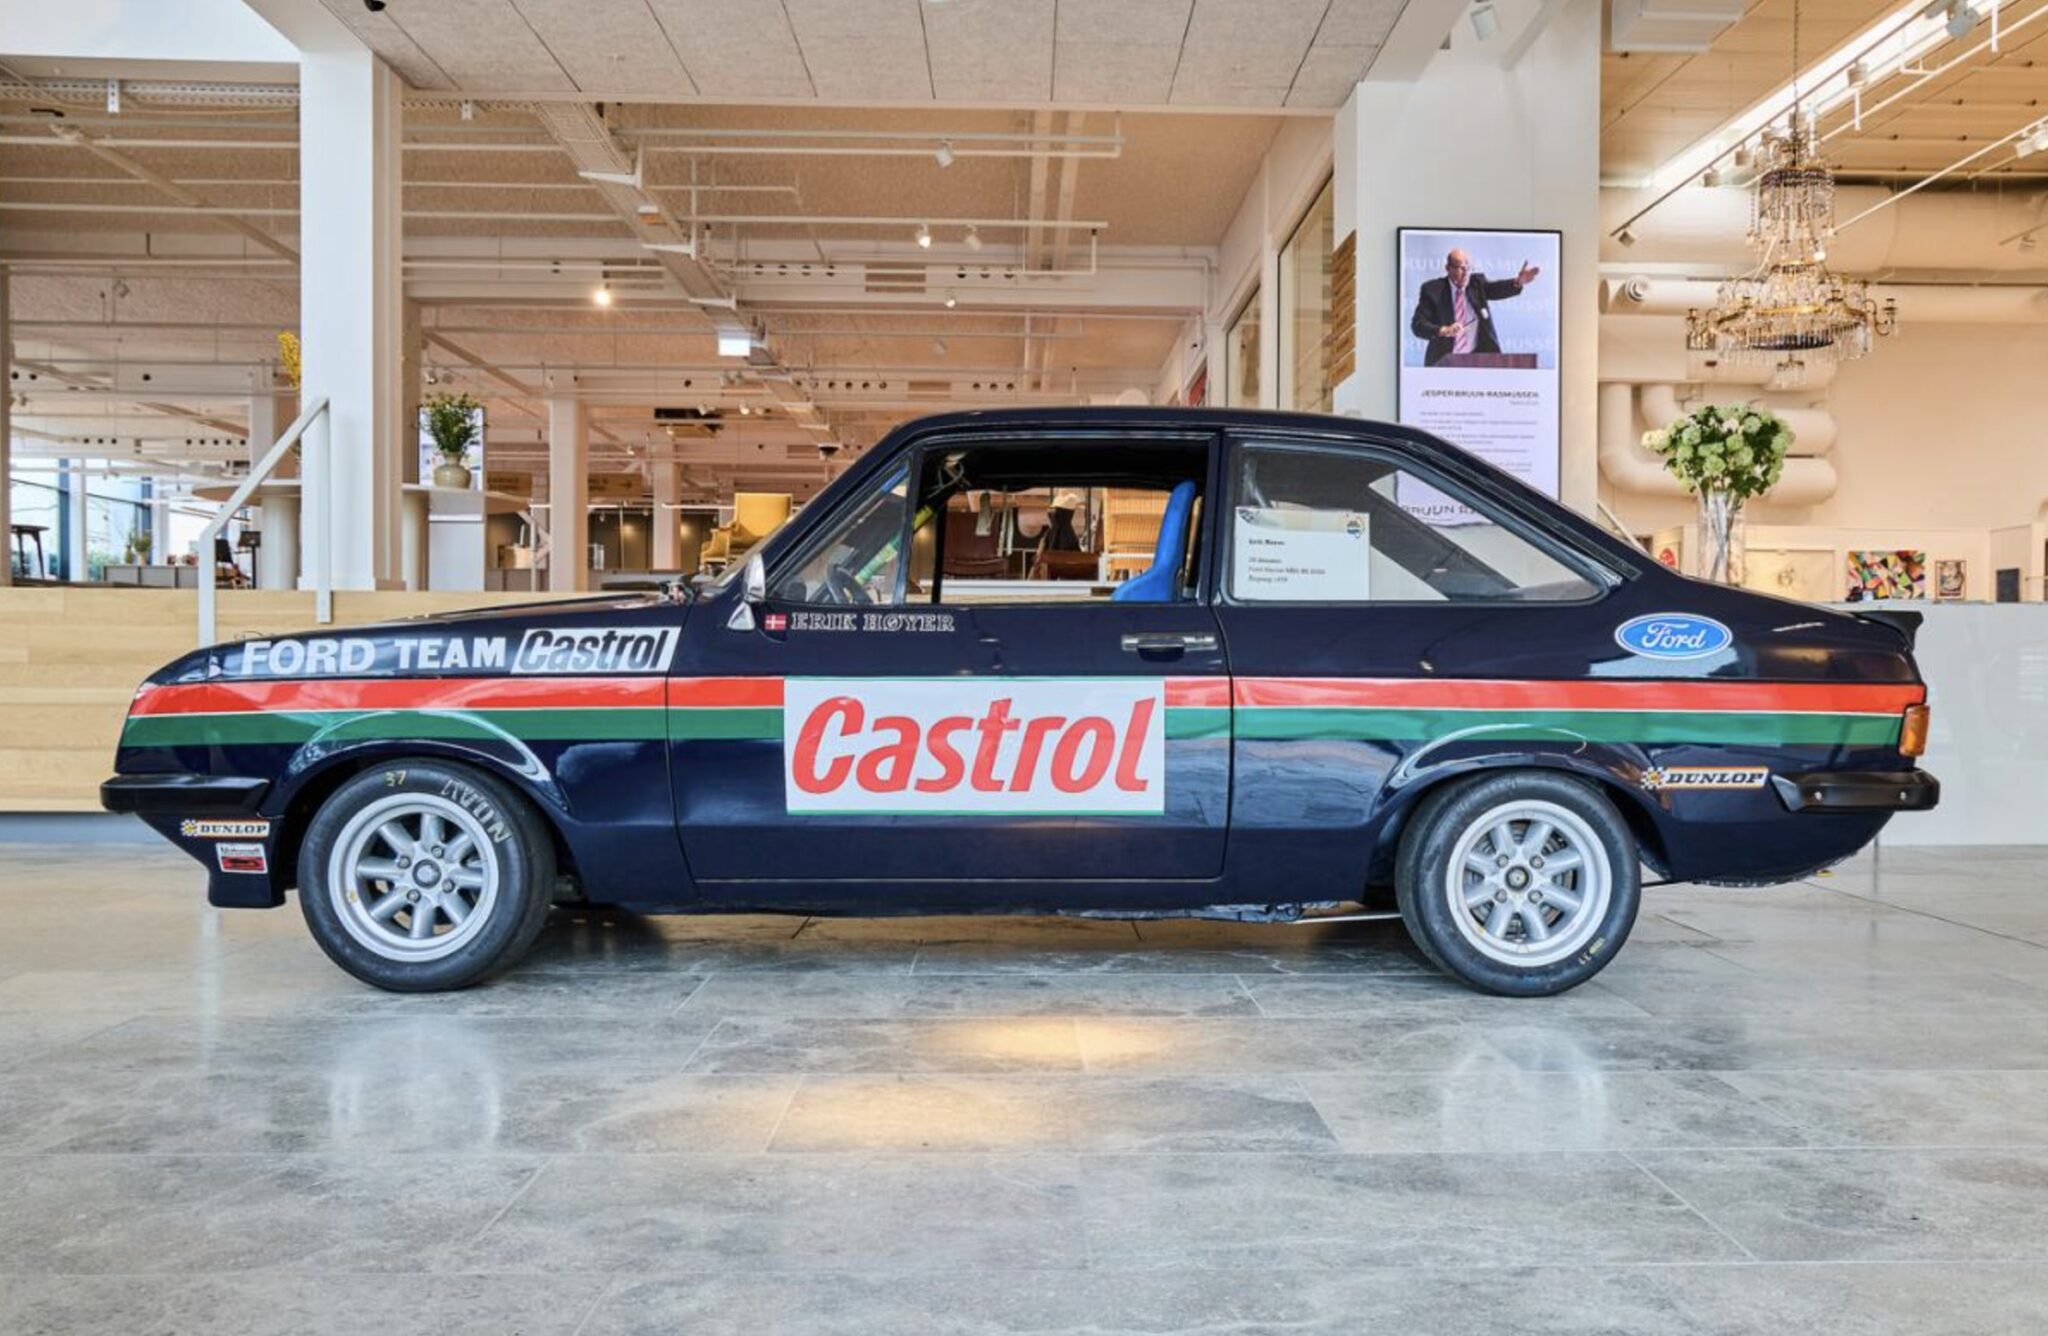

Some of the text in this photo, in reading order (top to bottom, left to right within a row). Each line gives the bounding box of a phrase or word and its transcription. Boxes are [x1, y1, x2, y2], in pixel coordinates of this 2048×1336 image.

[791, 612, 955, 632] ERIK HØYER
[1641, 622, 1707, 648] Ford
[240, 628, 671, 676] FORD TEAM Castrol
[792, 695, 1156, 794] Castrol
[384, 770, 407, 787] 37
[1666, 772, 1765, 785] DUNLOP
[440, 778, 513, 844] AVON
[200, 824, 267, 834] DUNLOP
